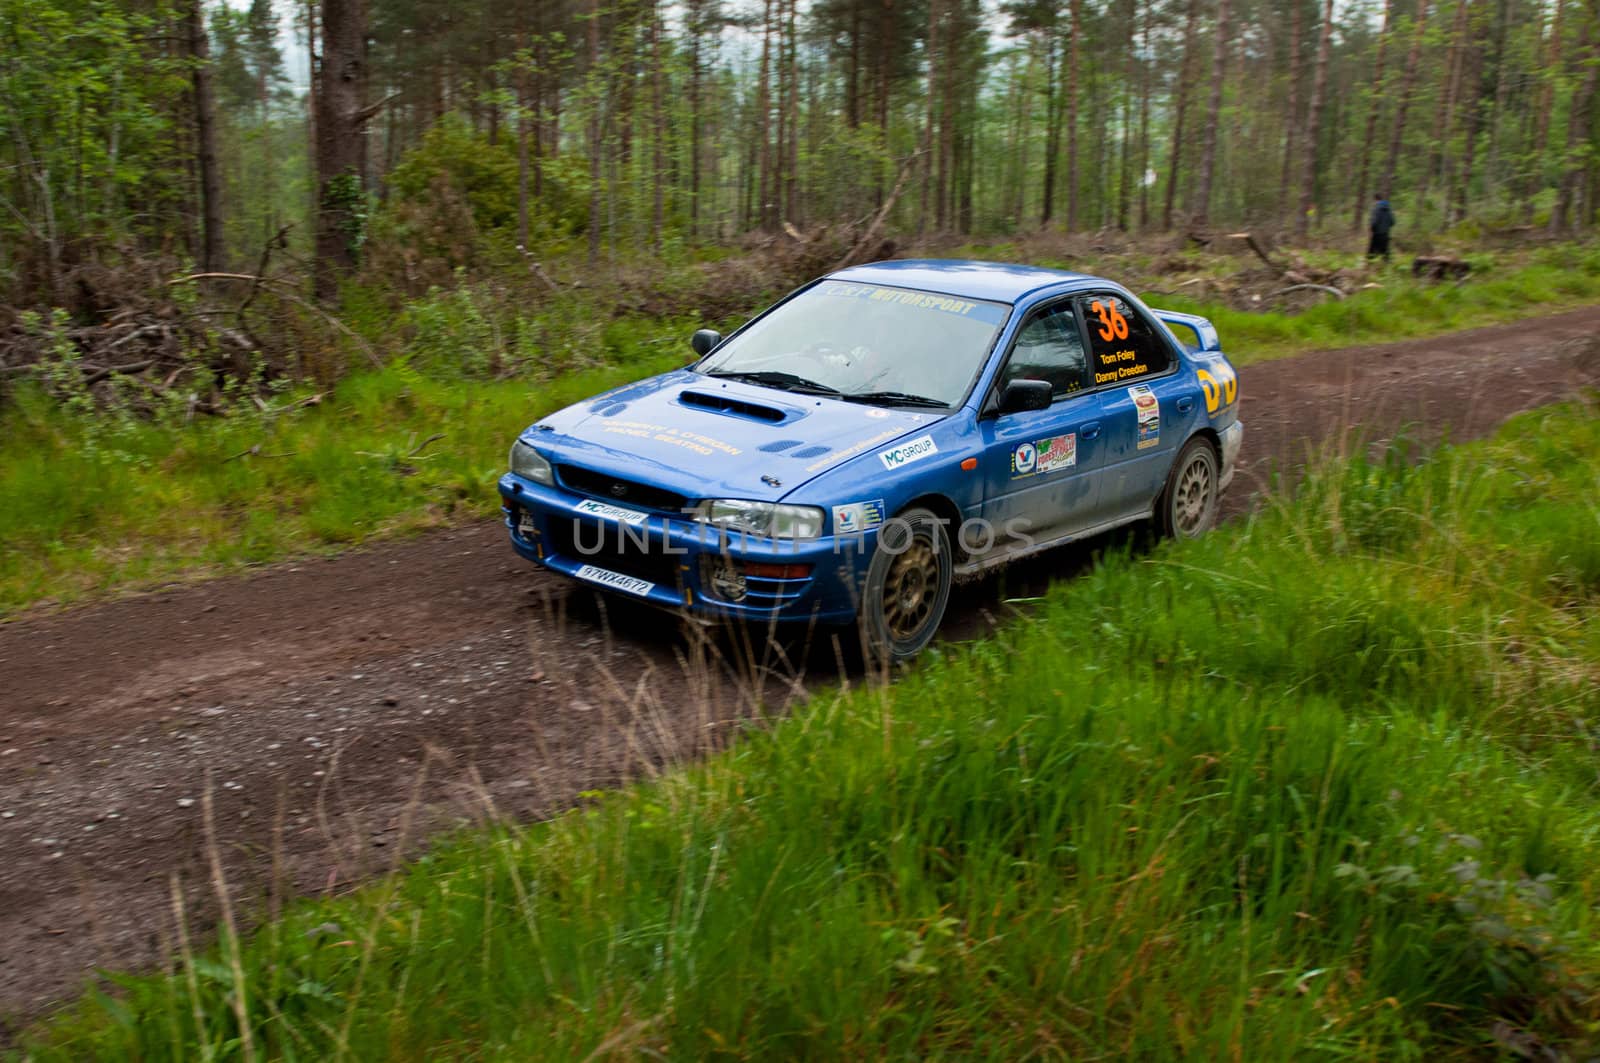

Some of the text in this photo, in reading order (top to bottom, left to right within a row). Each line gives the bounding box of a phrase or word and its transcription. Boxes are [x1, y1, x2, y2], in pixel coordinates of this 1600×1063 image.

[871, 289, 976, 314] MOTORSPORT
[1091, 300, 1129, 342] 36
[1100, 349, 1135, 365] Tom Foley
[1095, 363, 1148, 383] Danny Creedon
